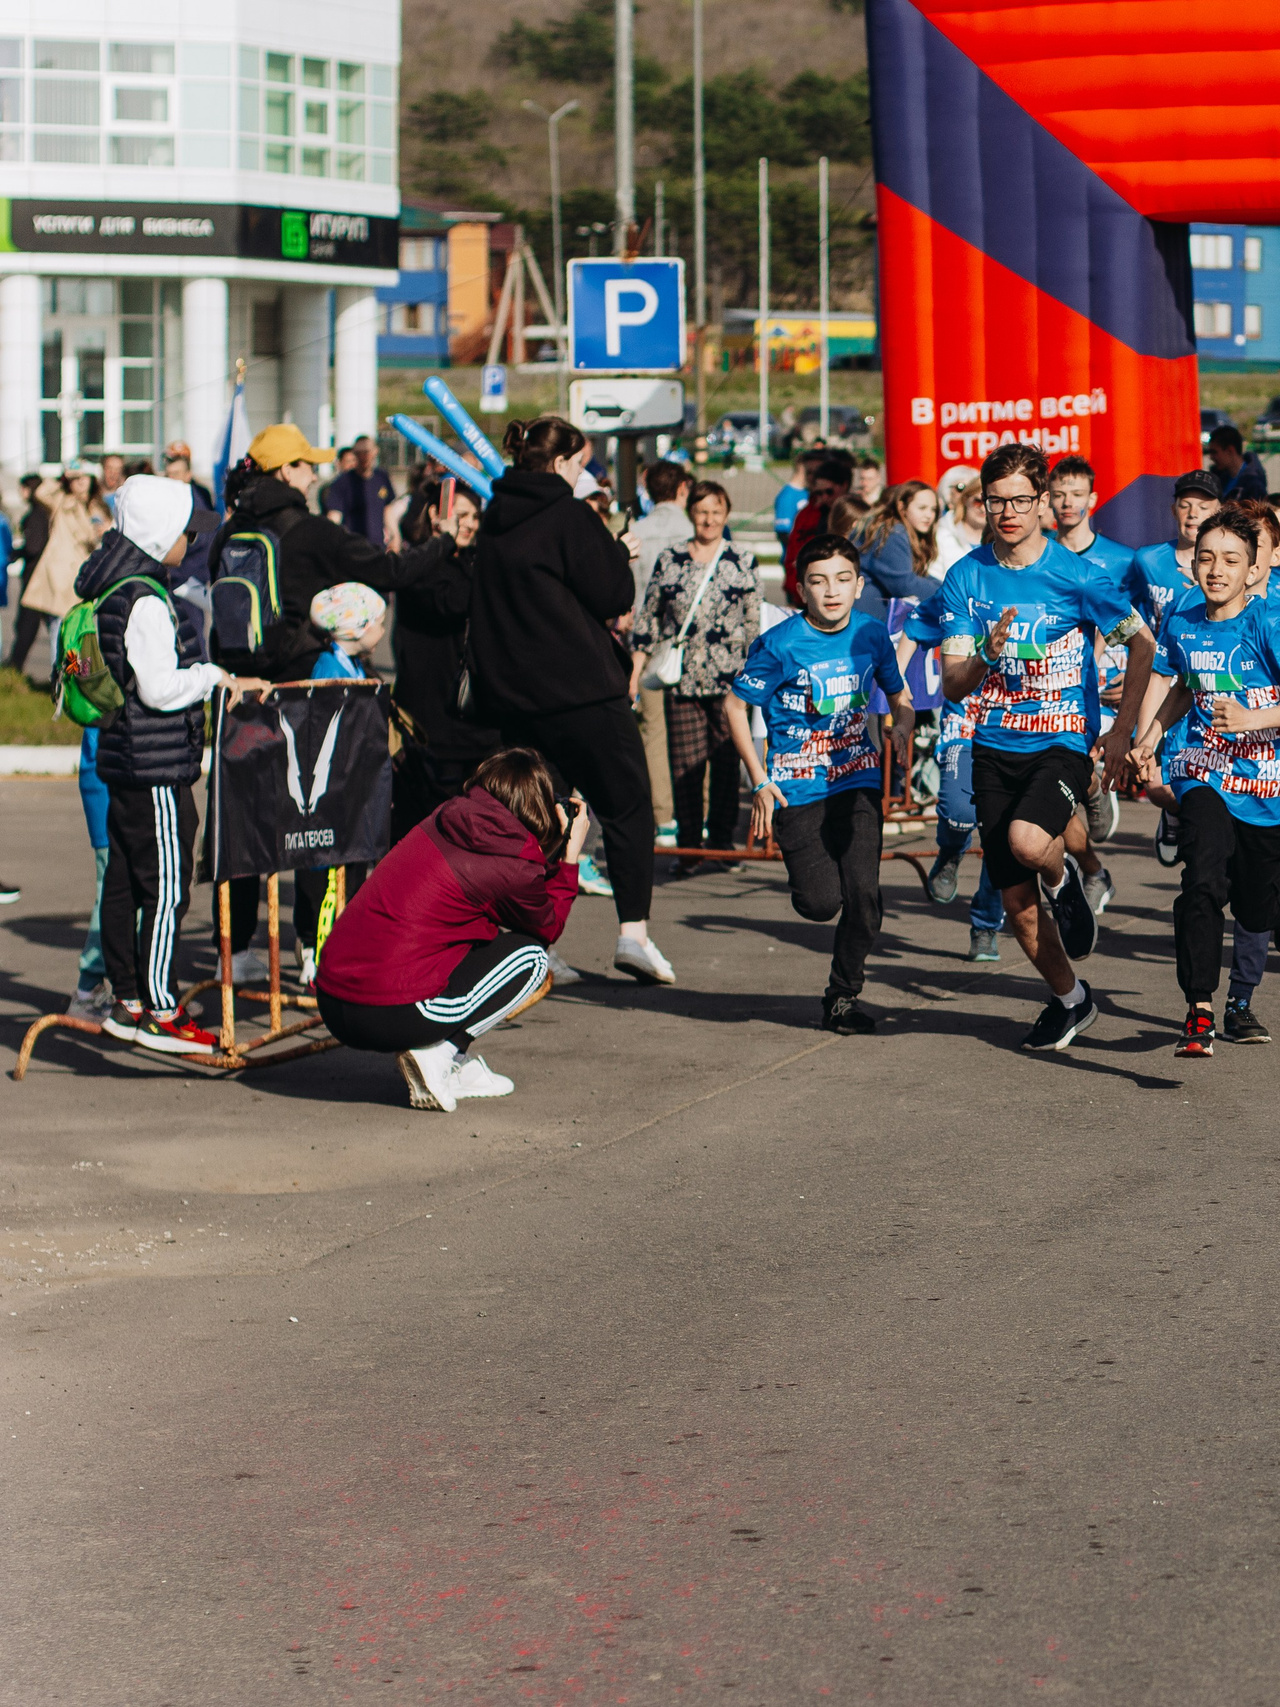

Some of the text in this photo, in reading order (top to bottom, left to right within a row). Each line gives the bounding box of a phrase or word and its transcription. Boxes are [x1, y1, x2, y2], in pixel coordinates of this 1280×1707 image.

[32, 214, 95, 235] УСЛУГИ
[142, 217, 215, 238] БИЗНЕСА
[604, 278, 659, 357] P
[911, 387, 1107, 428] В ритме всей
[986, 619, 1031, 641] 147
[1189, 650, 1226, 672] 10052
[305, 828, 335, 849] ГЕРОЕВ
